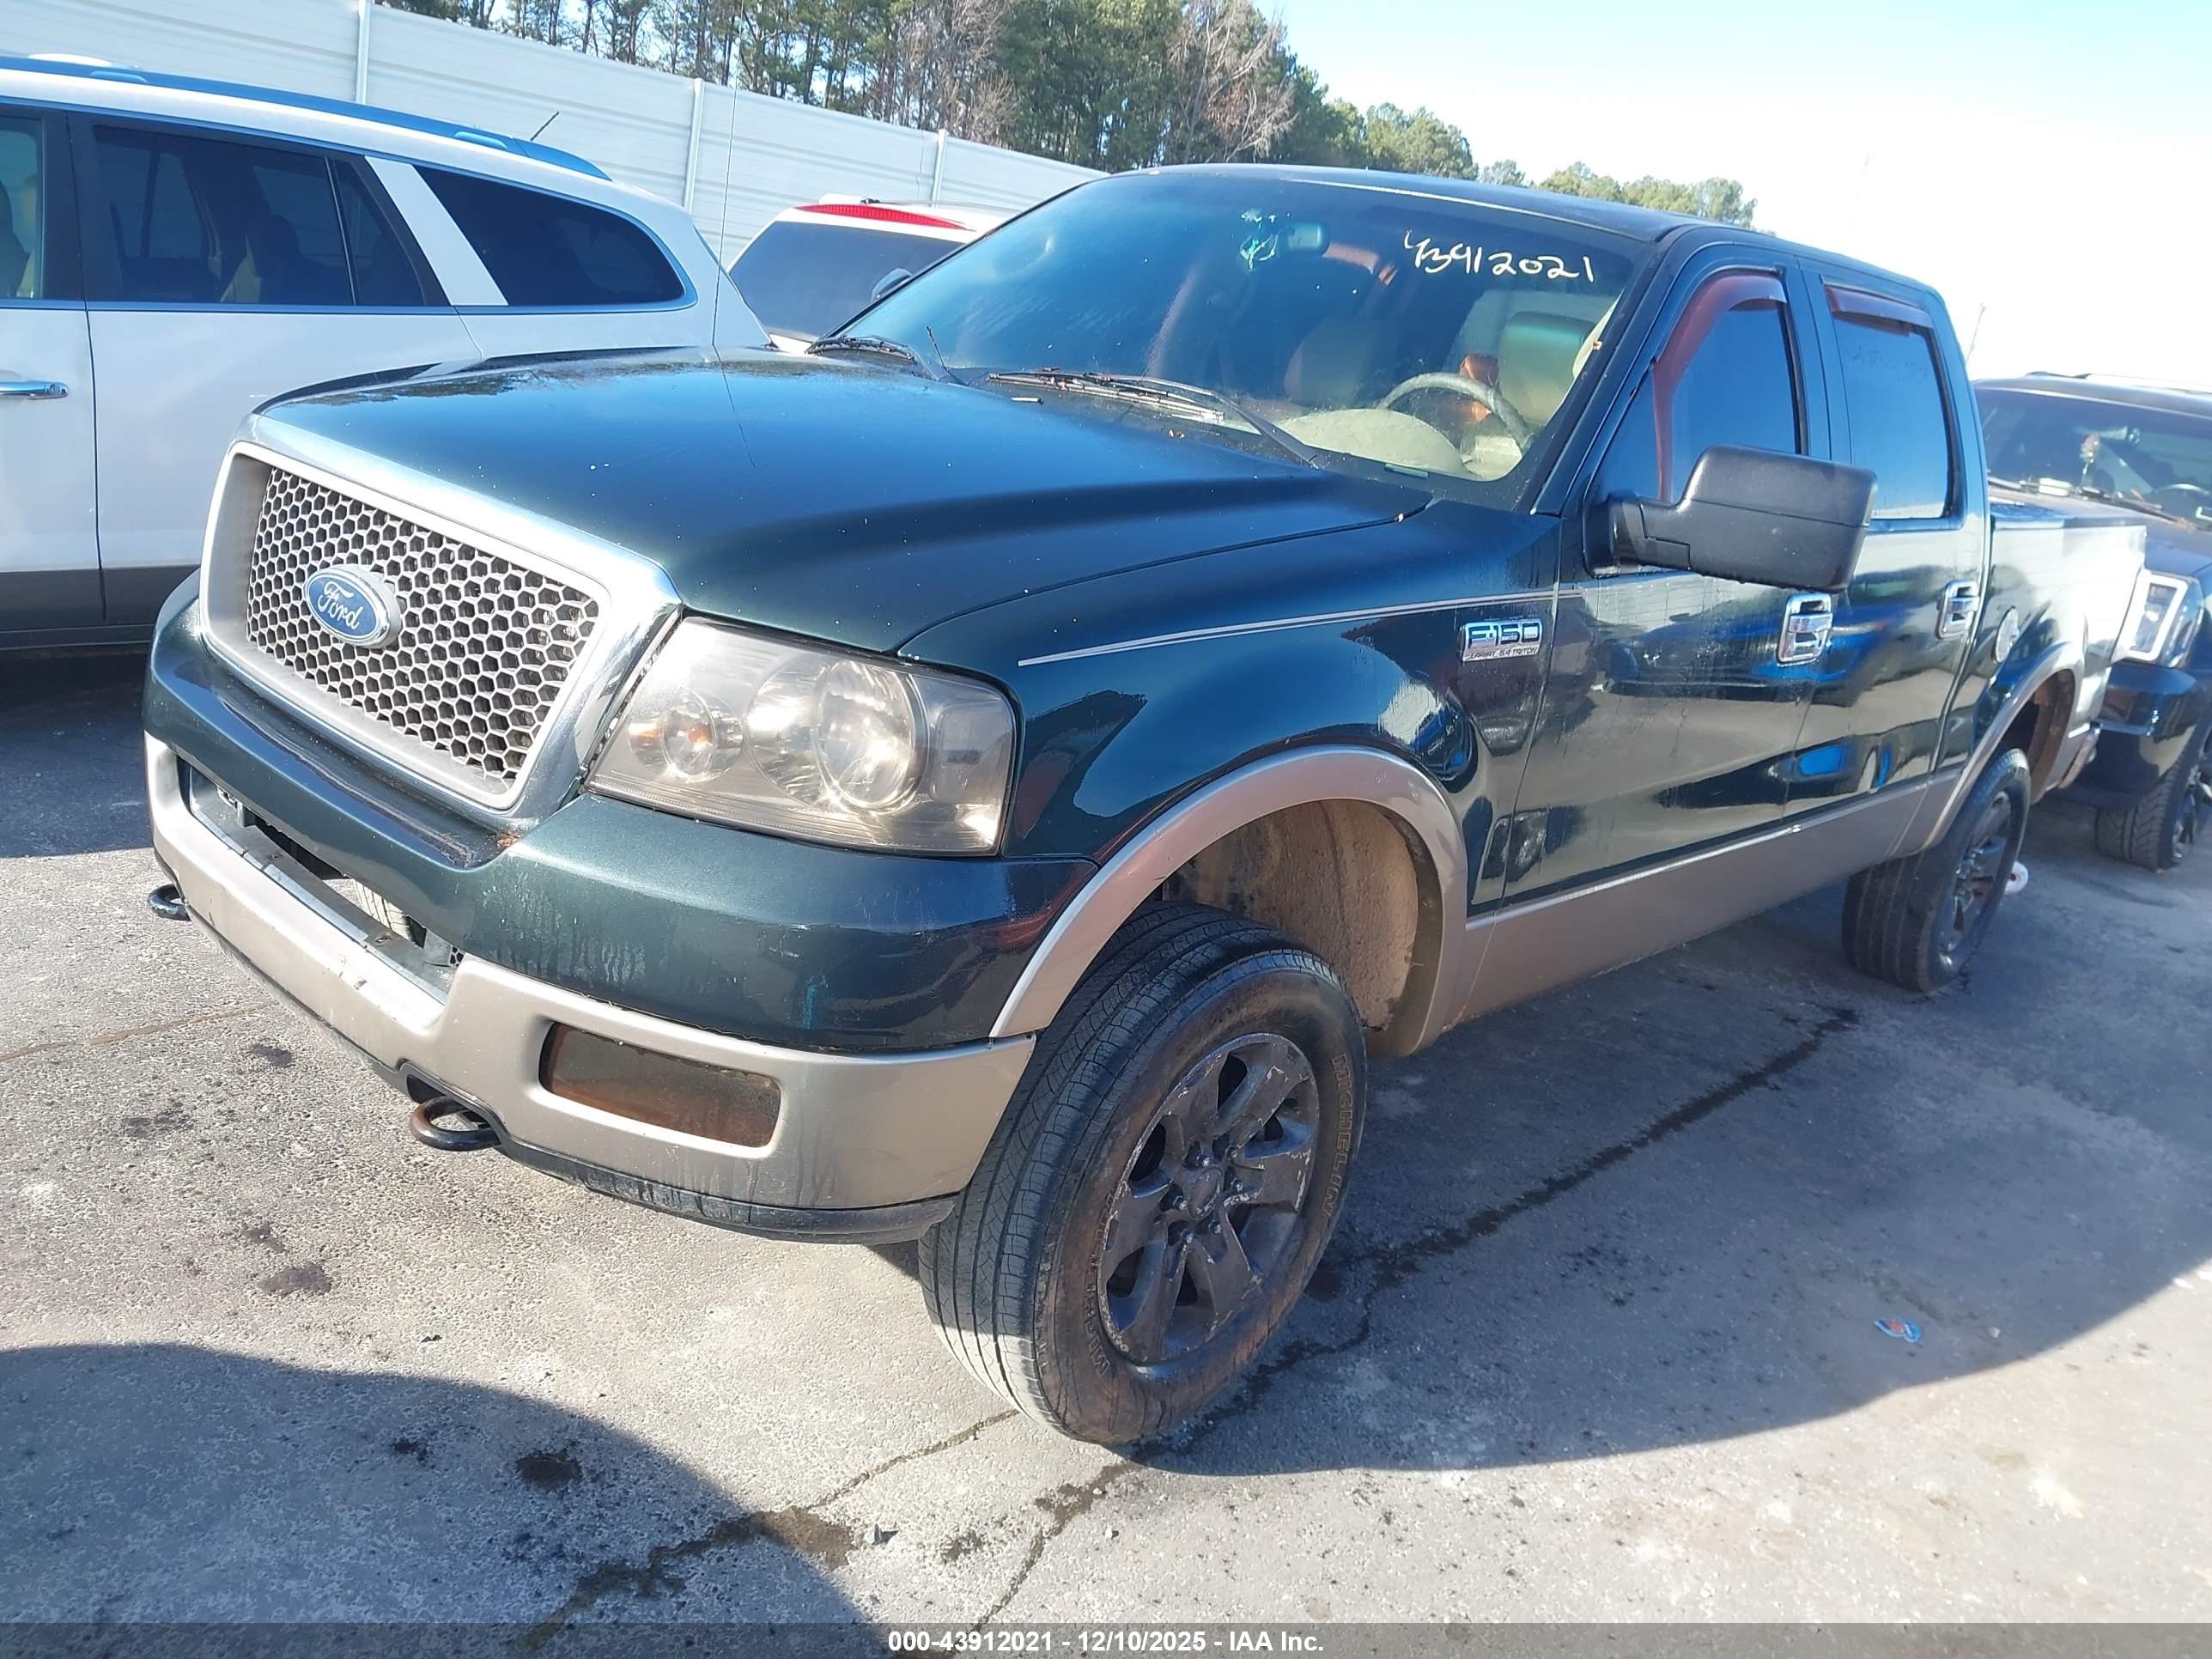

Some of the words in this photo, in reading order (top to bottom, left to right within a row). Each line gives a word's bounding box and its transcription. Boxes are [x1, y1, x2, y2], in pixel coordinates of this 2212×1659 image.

[1404, 229, 1594, 283] 43912021
[317, 580, 364, 630] Ford
[1512, 647, 1537, 656] TRITON
[1322, 1053, 1354, 1216] MICHELIN
